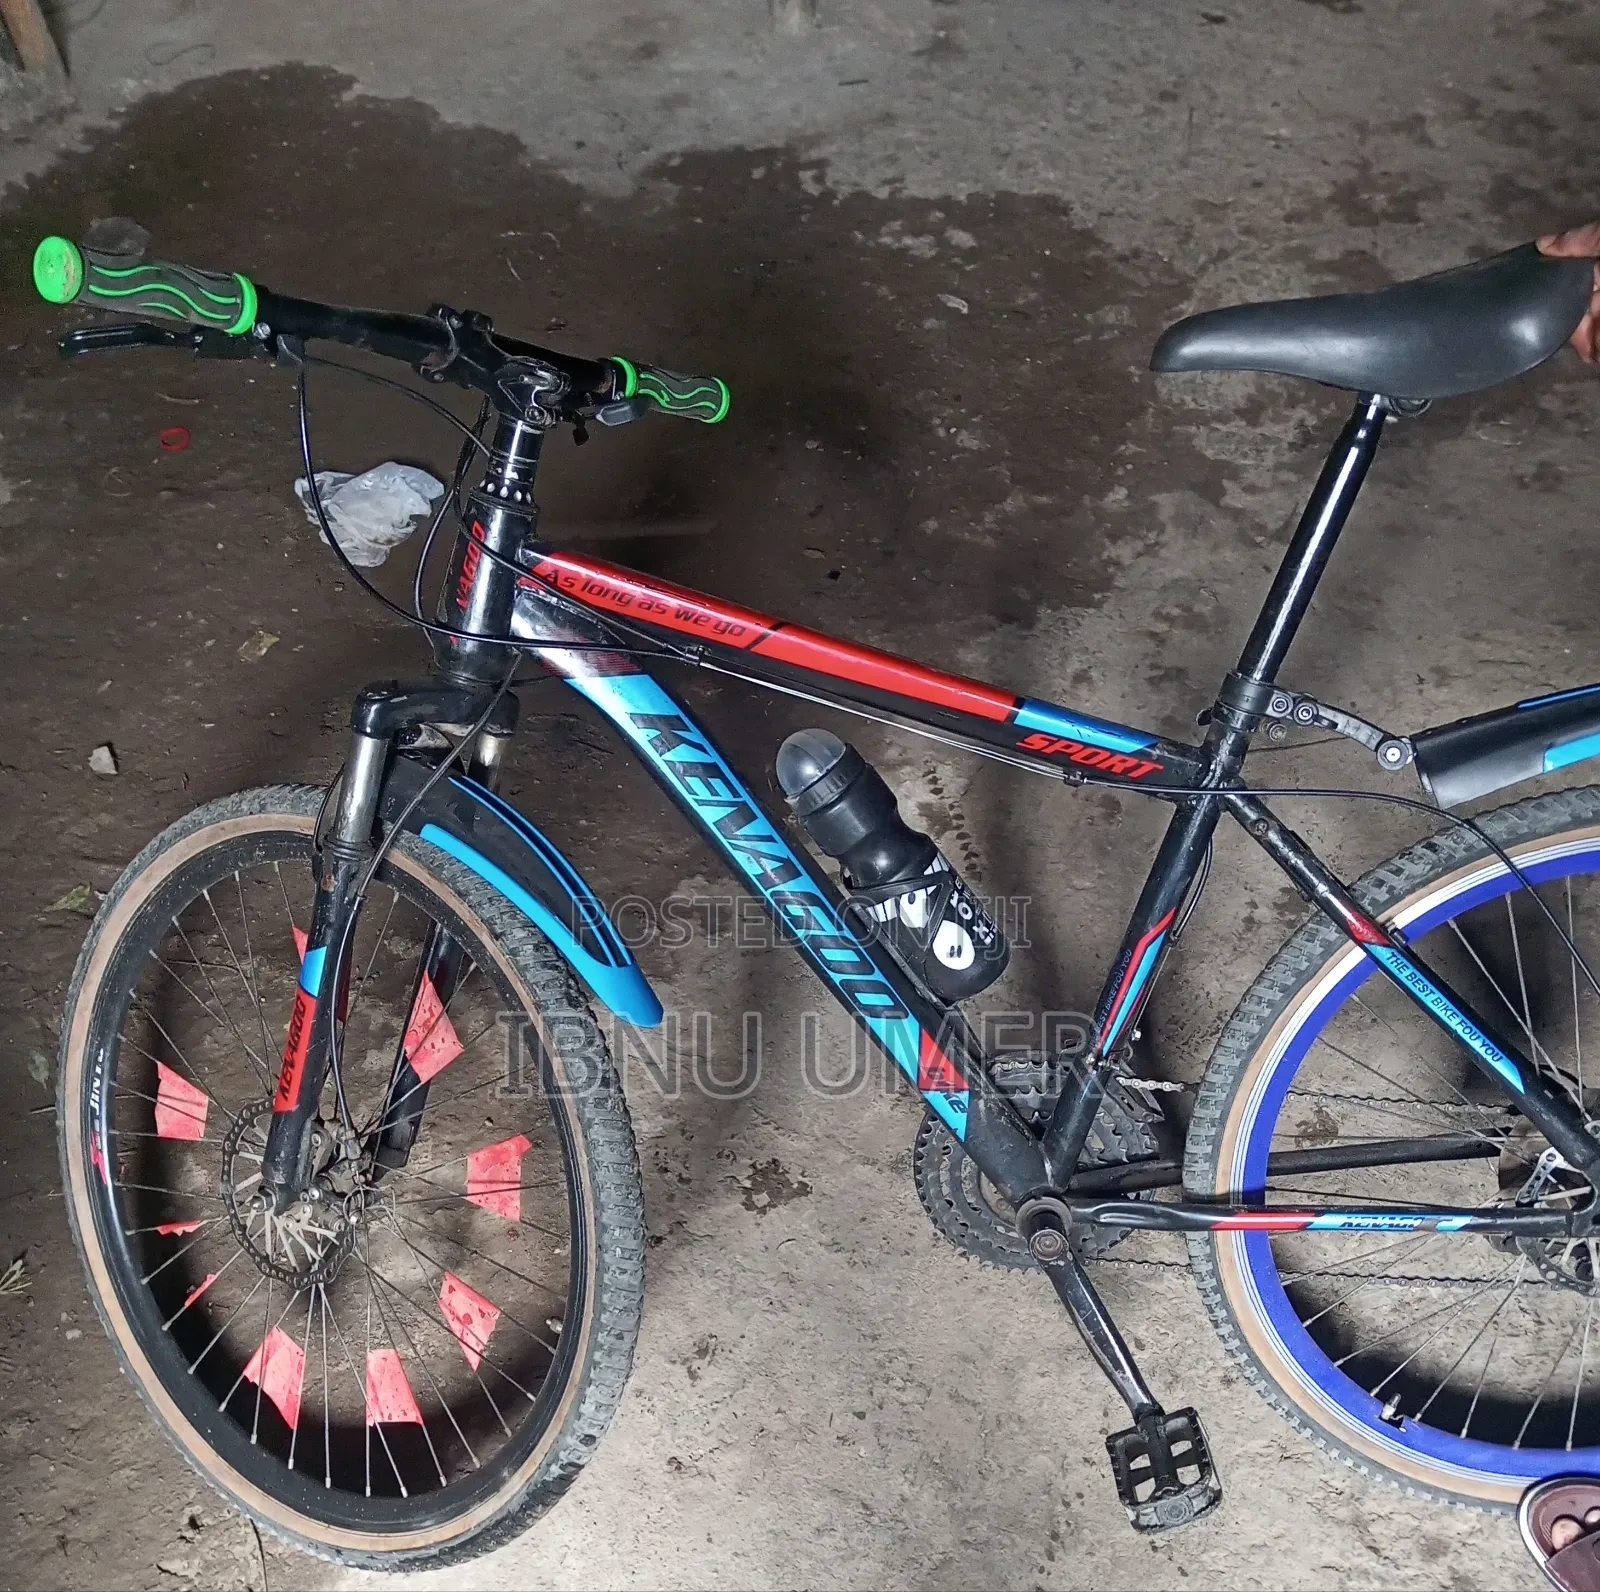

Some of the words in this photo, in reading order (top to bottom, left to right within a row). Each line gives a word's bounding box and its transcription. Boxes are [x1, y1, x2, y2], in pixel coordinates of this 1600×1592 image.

[545, 569, 577, 589] As
[580, 579, 636, 607] long
[637, 599, 671, 615] as
[674, 607, 711, 627] we
[712, 620, 747, 638] go
[1016, 733, 1165, 779] SPORT
[629, 712, 911, 1020] KENAGOO
[1120, 949, 1132, 968] YOU
[1386, 951, 1409, 975] THE
[1404, 970, 1436, 998] BEST
[1430, 996, 1460, 1022] BIKE
[1455, 1019, 1481, 1042] FOU
[1478, 1039, 1504, 1063] YOU
